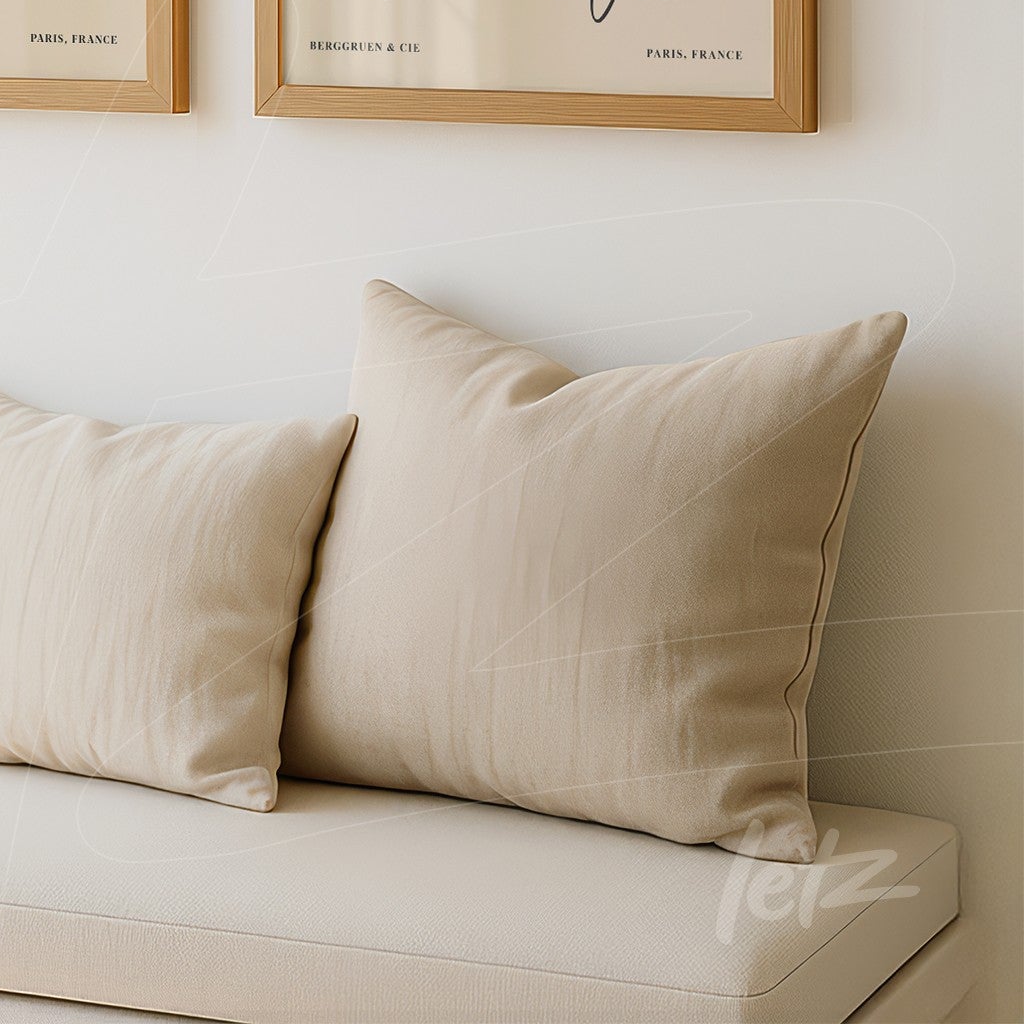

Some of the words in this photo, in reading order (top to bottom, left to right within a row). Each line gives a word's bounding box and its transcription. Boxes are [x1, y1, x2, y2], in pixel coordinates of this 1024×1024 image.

[30, 33, 68, 45] PARIS,
[71, 34, 118, 45] FRANCE
[309, 40, 382, 52] BERGGRUEN
[386, 42, 396, 52] &
[399, 42, 421, 53] CIE
[646, 48, 688, 59] PARIS,
[691, 49, 743, 61] FRANCE
